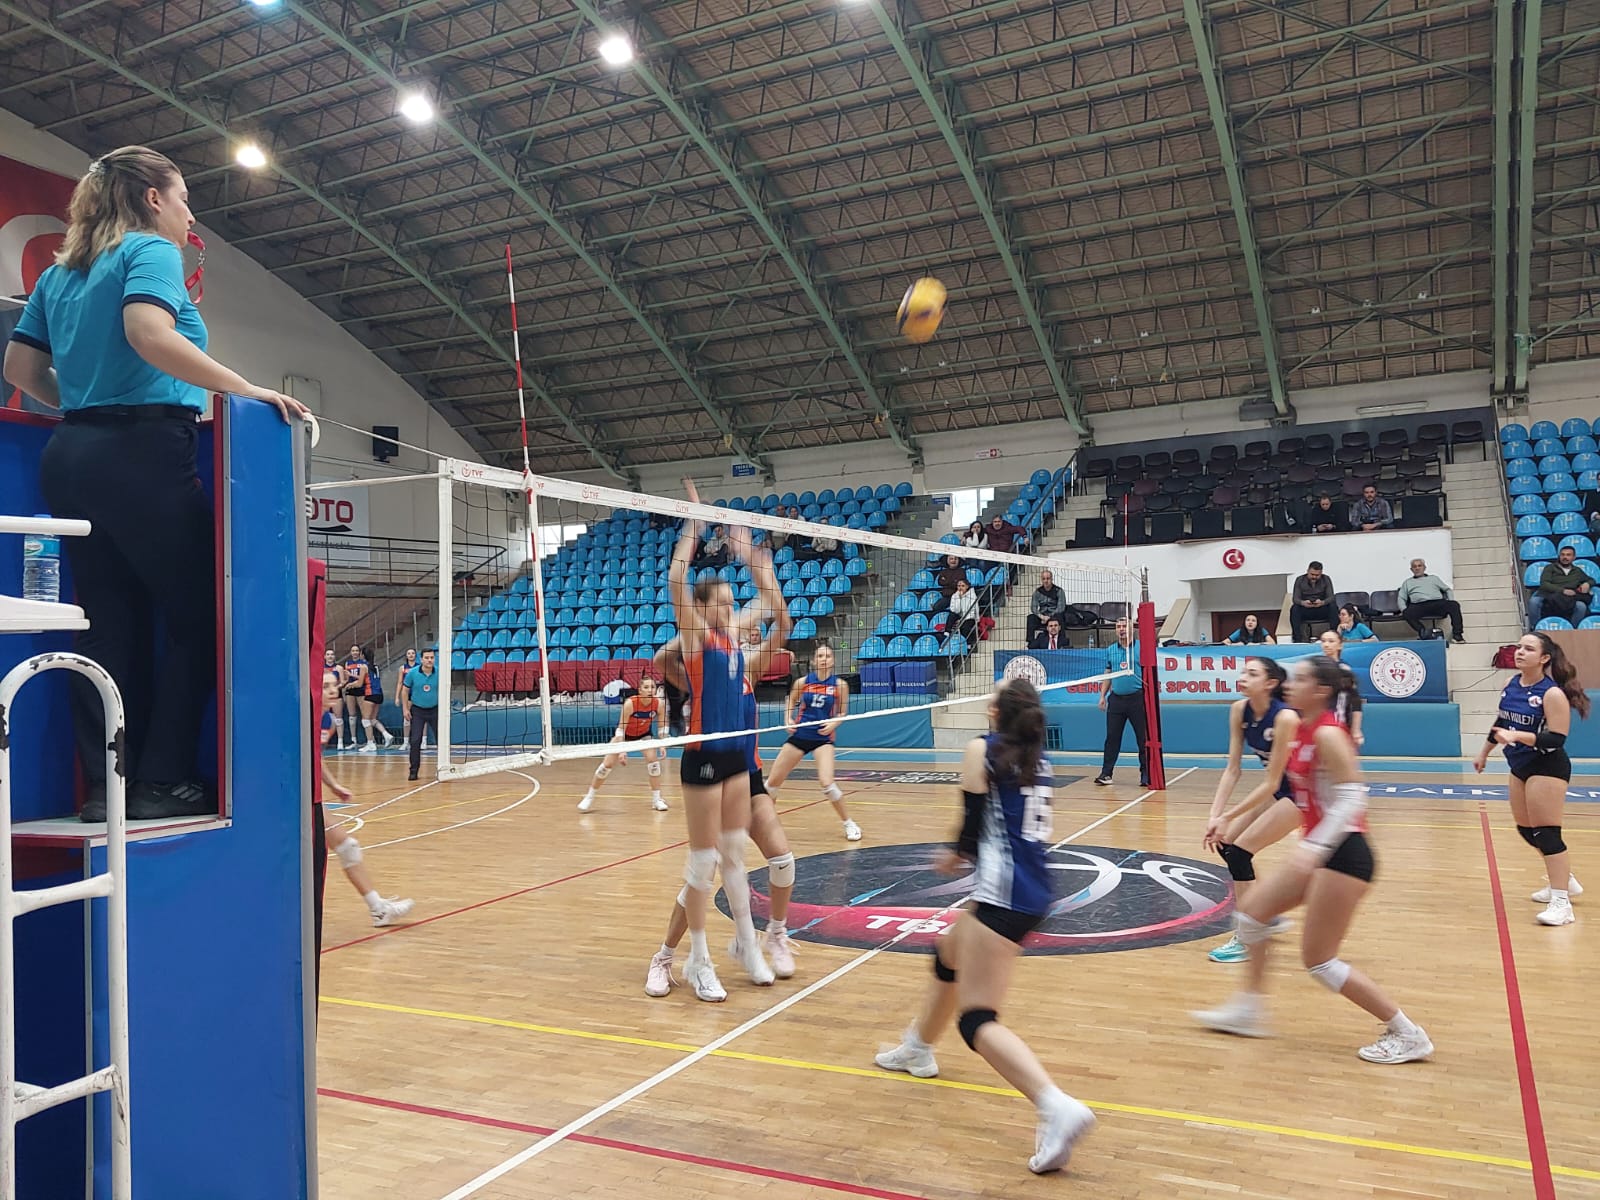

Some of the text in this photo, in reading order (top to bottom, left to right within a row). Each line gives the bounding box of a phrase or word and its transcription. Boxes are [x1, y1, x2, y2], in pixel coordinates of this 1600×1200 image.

[1165, 654, 1261, 671] DİRN
[1165, 680, 1212, 693] SPOR
[1215, 678, 1232, 693] İL
[811, 694, 826, 708] 15
